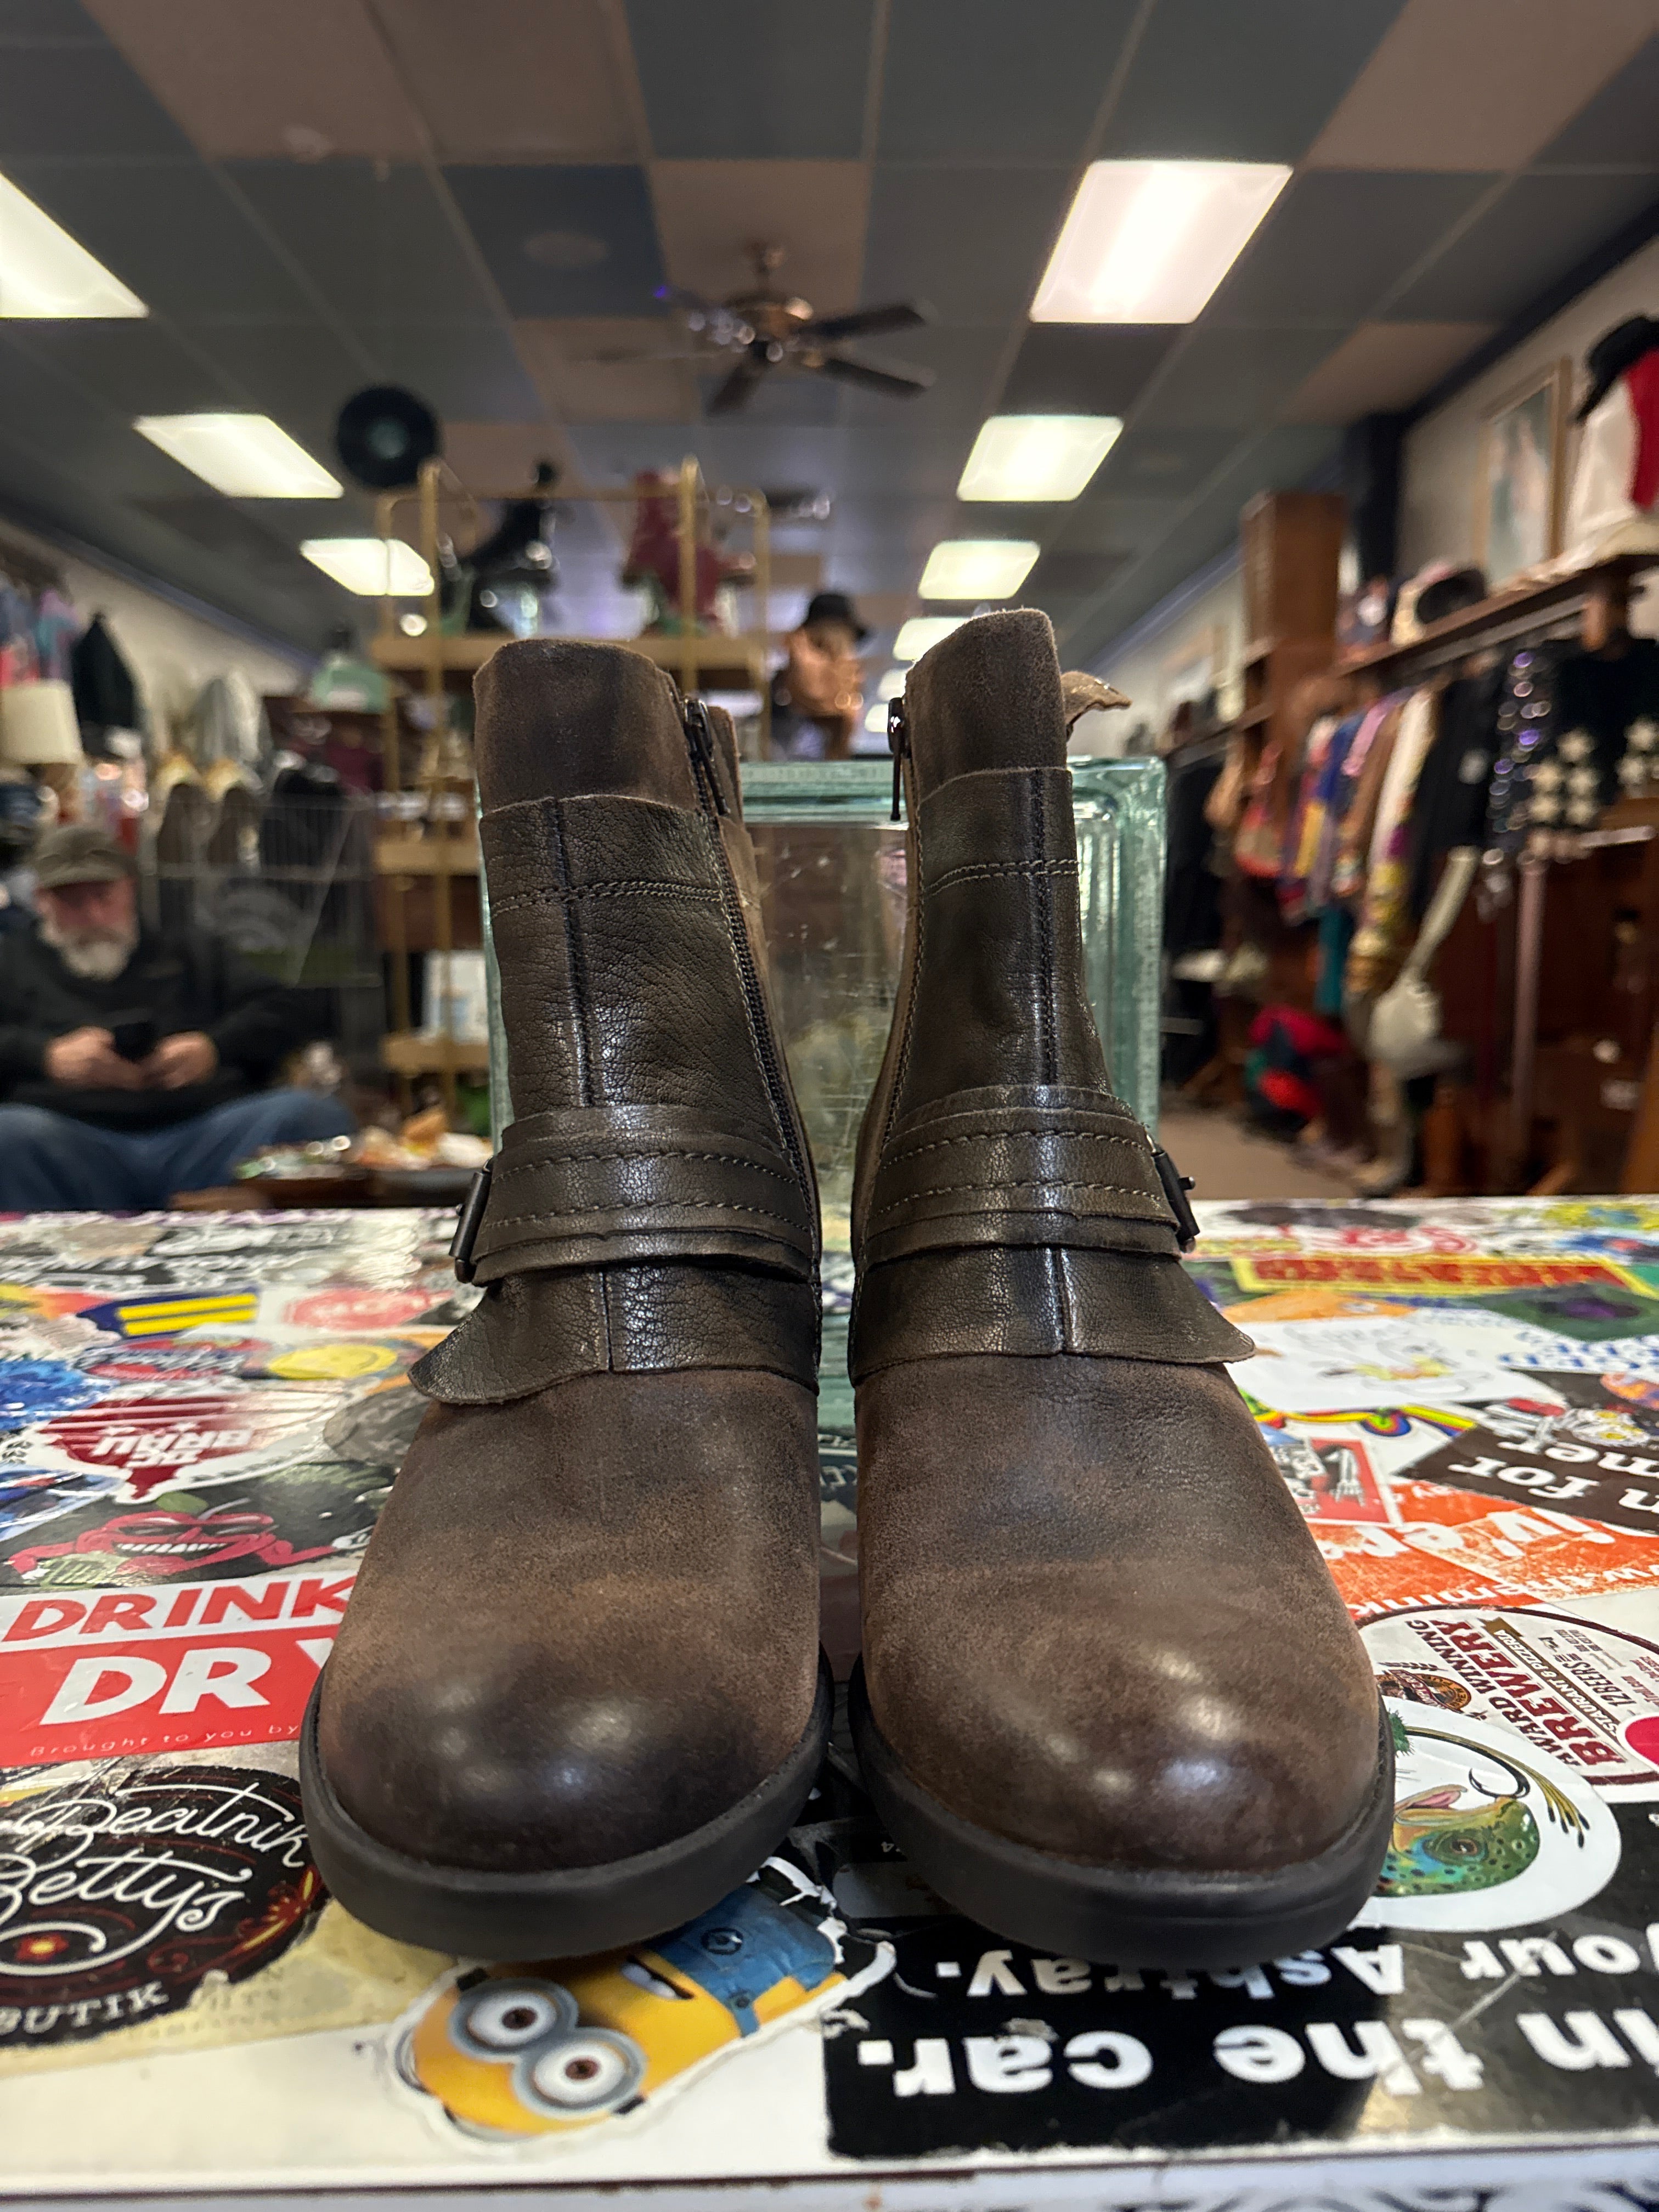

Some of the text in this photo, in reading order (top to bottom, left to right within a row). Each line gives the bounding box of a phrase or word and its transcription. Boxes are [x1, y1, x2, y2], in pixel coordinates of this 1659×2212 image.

[1448, 1456, 1600, 1499] for
[2, 1576, 357, 1642] DRINK
[1405, 1619, 1498, 1695] WINNING
[1488, 1696, 1582, 1767] AWARD
[1429, 1618, 1626, 1767] BREWERY
[1493, 1629, 1549, 1670] PIZZERIA
[1548, 1678, 1618, 1735] STAURANT
[30, 1724, 300, 1757] Brought to you by
[11, 1781, 309, 1875] Beatnik
[857, 2030, 1154, 2097] car.
[1214, 2018, 1485, 2097] the
